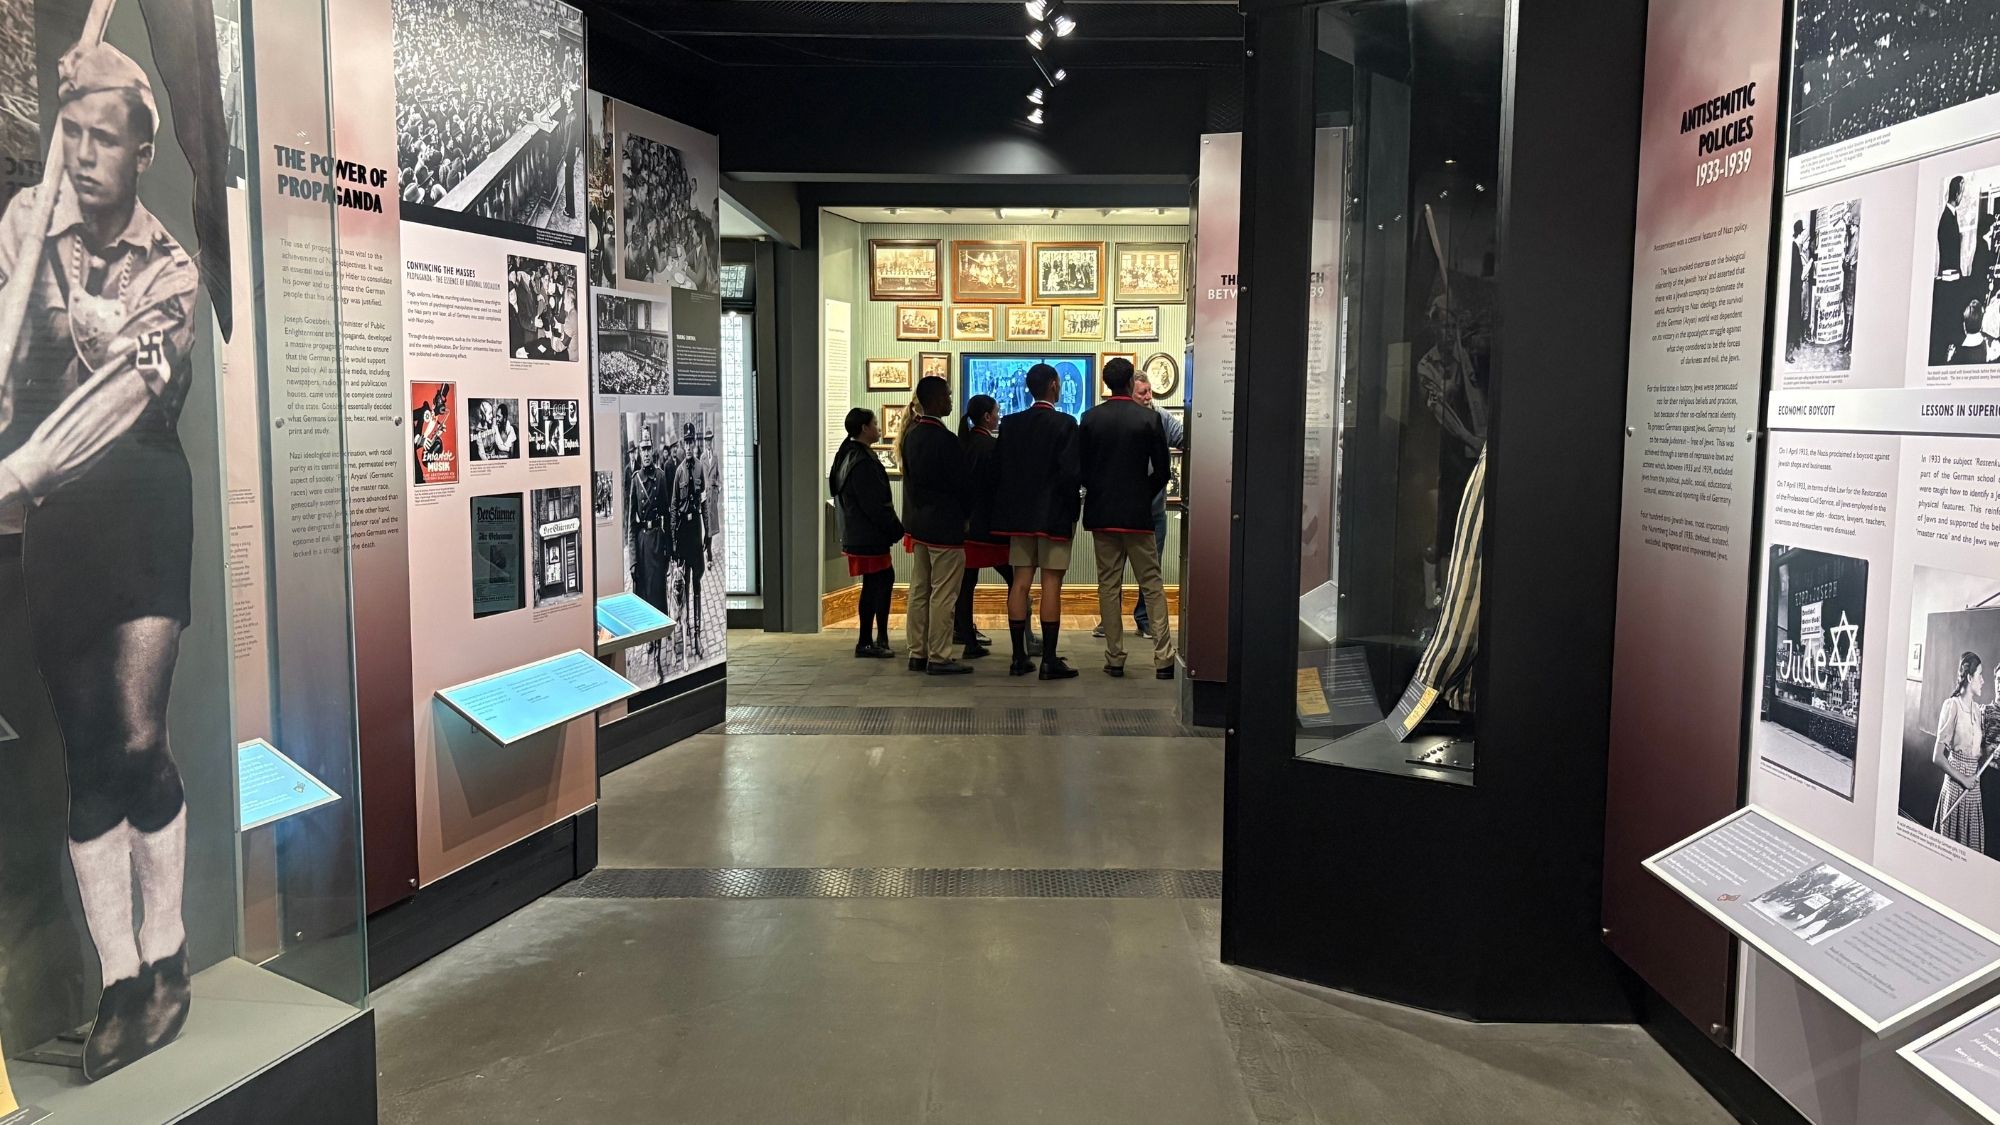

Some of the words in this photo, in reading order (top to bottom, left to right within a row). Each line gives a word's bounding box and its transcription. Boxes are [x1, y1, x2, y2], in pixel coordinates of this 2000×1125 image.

[1680, 81, 1756, 135] ANTISEMITIC
[1698, 115, 1754, 157] POLICIES
[273, 145, 306, 171] THE
[310, 153, 367, 185] POWER
[369, 167, 388, 189] OF
[1695, 147, 1752, 187] 1933-1939
[277, 174, 383, 214] PROPAGANDA
[280, 238, 292, 247] The
[356, 250, 366, 258] vital
[406, 260, 442, 273] CONVINCING
[443, 265, 454, 275] THE
[455, 268, 476, 278] MASSES
[282, 277, 291, 285] his
[292, 279, 310, 287] power
[356, 285, 364, 293] the
[365, 286, 386, 295] German
[435, 275, 443, 284] THE
[283, 291, 303, 299] people
[284, 315, 303, 324] Joseph
[370, 321, 385, 330] Public
[367, 334, 392, 342] developed
[286, 365, 299, 373] Nazi
[369, 369, 390, 377] including
[348, 403, 373, 411] essentially
[1778, 405, 1807, 415] ECONOMIC
[1809, 405, 1835, 416] BOYCOTT
[1921, 404, 1954, 417] LESSONS
[1956, 405, 1965, 416] IN
[1968, 405, 2000, 417] SUPERI
[302, 414, 327, 422] Germans
[289, 452, 303, 460] Nazi
[1789, 448, 1798, 456] April
[427, 461, 451, 473] MUSIK
[1791, 461, 1801, 469] shops
[1921, 454, 1926, 463] In
[1928, 455, 1941, 464] 1933
[1942, 456, 1952, 465] the
[1953, 457, 1972, 467] subject
[1920, 471, 1931, 479] part
[1933, 470, 1939, 478] of
[1941, 472, 1950, 480] the
[1952, 471, 1974, 481] German
[1977, 474, 1995, 483] school
[1786, 481, 1796, 489] April
[1811, 484, 1823, 492] terms
[1836, 486, 1845, 494] Law
[1861, 489, 1888, 498] Restoration
[1932, 486, 1948, 496] taught
[1950, 487, 1961, 495] how
[1969, 489, 1989, 500] identify
[1809, 496, 1818, 504] Civil
[1819, 498, 1835, 506] Service,
[1840, 500, 1851, 509] Jews
[1851, 502, 1873, 511] employed
[1878, 504, 1886, 512] the
[1918, 500, 1939, 509] physical
[1942, 502, 1965, 512] features.
[1969, 504, 1982, 513] This
[1783, 507, 1796, 515] service
[1816, 510, 1824, 518] jobs
[1828, 512, 1845, 522] doctors,
[1800, 522, 1822, 531] researchers
[1823, 525, 1834, 533] were
[1923, 515, 1936, 524] Jews
[1937, 516, 1948, 525] and
[1950, 519, 1978, 528] supported
[1980, 522, 1989, 531] the
[366, 529, 386, 537] Germans
[1951, 534, 1961, 542] and
[1962, 535, 1972, 544] the
[1973, 536, 1987, 546] Jews
[1780, 639, 1828, 690] Jude
